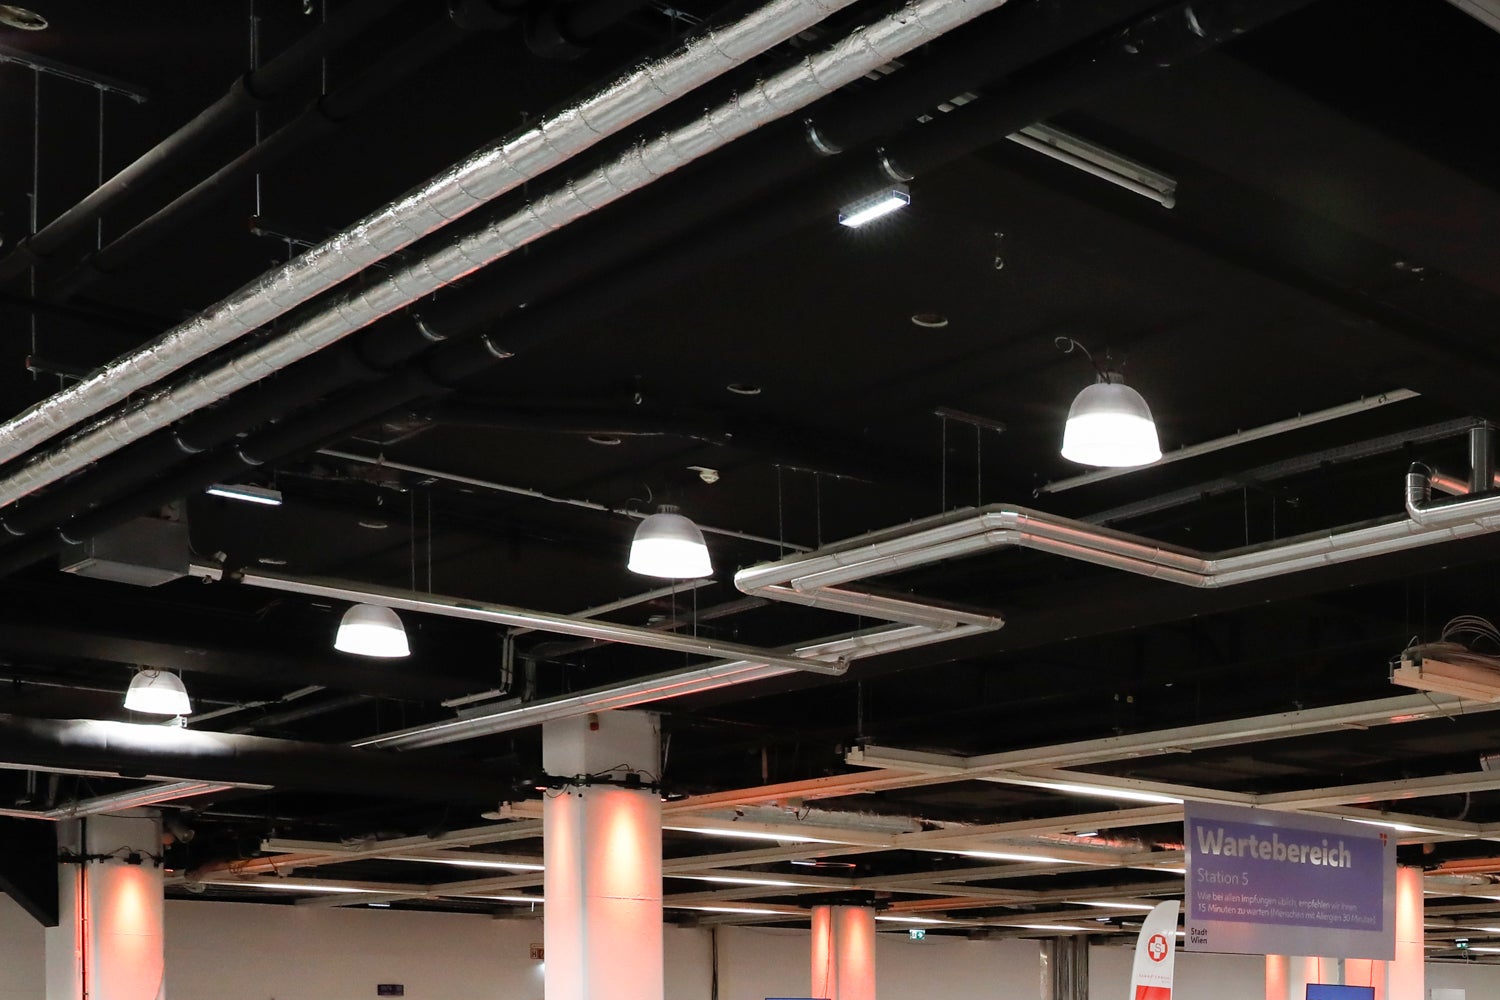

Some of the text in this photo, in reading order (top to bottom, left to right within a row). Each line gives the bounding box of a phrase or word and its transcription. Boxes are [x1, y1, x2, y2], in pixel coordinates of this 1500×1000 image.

[1196, 825, 1352, 869] Wartebereich
[1197, 867, 1249, 886] Station 5
[1197, 891, 1211, 901] Wie
[1212, 892, 1223, 901] bei
[1241, 893, 1277, 907] Impfungen
[1298, 898, 1330, 910] empfehlen
[1198, 903, 1206, 913] 15
[1207, 904, 1237, 914] Minuten
[1237, 907, 1246, 915] zu
[1246, 908, 1270, 917] warten
[1343, 913, 1351, 922] 30
[1190, 927, 1208, 936] Stadt
[1190, 936, 1208, 944] Wien
[1155, 942, 1162, 953] S
